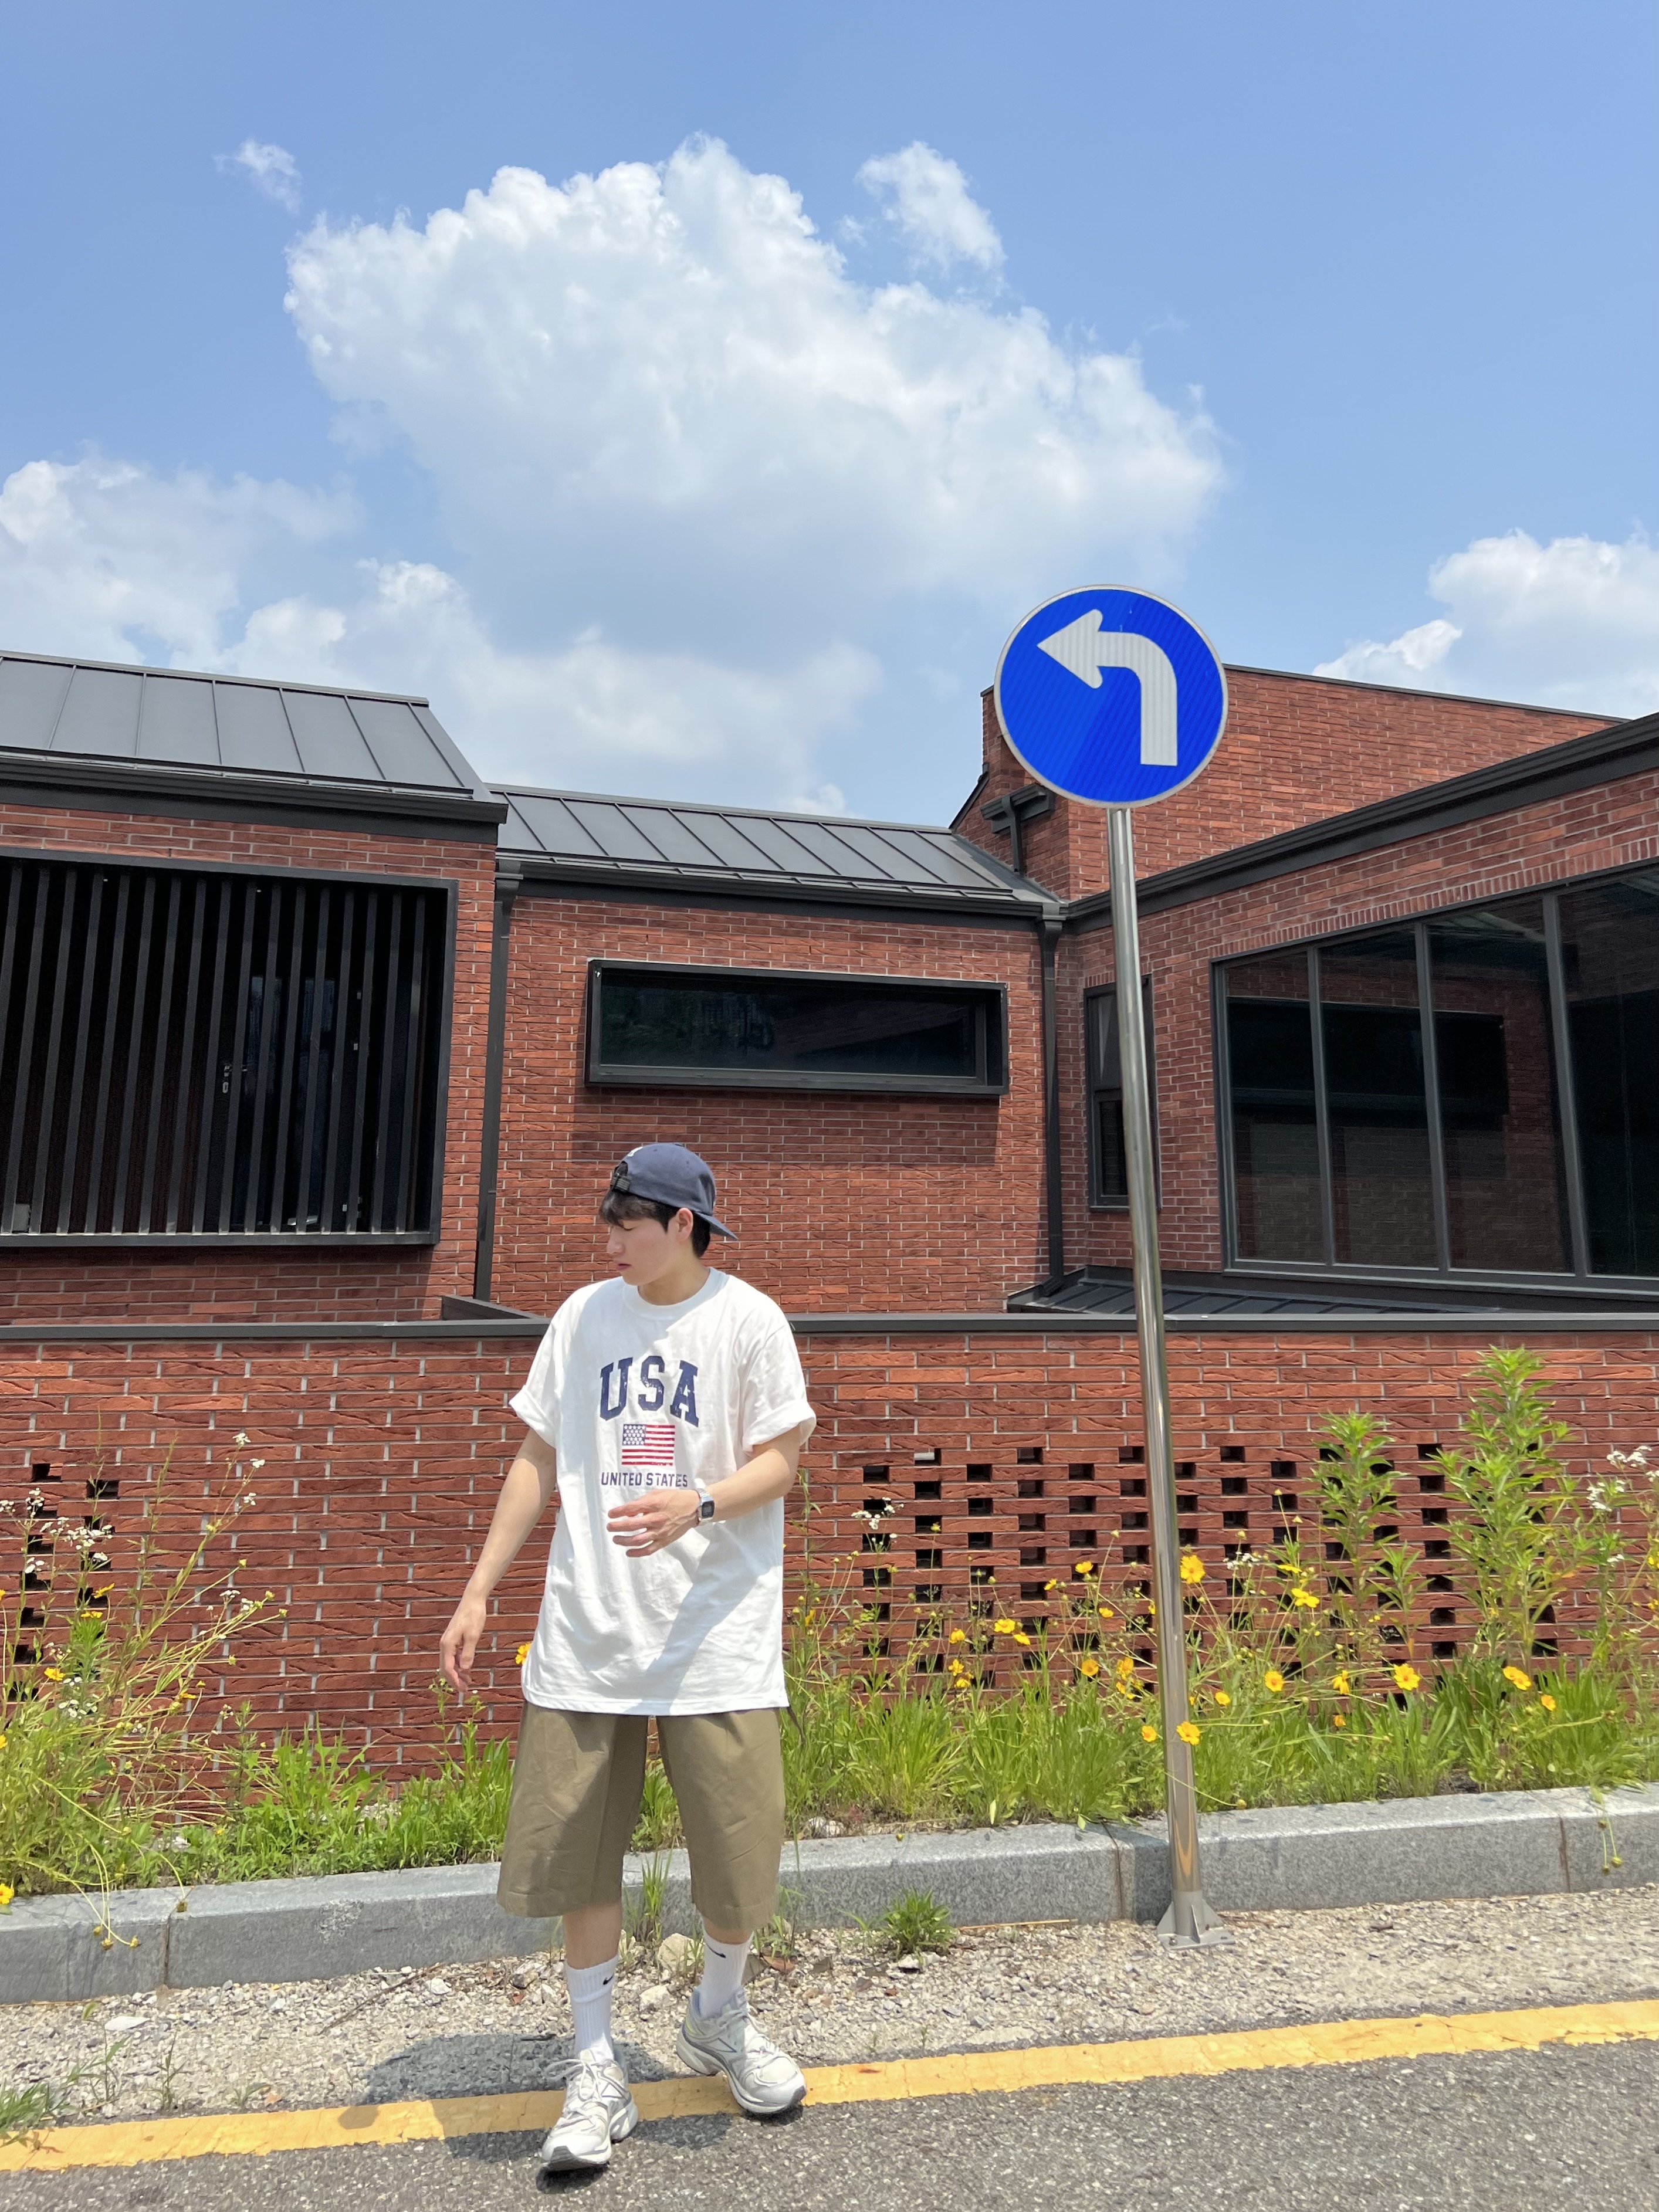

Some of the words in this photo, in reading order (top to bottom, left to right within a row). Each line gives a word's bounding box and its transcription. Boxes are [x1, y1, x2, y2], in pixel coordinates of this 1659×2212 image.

[600, 1355, 699, 1428] USA
[601, 1472, 642, 1486] UNITED
[646, 1472, 688, 1488] STATES
